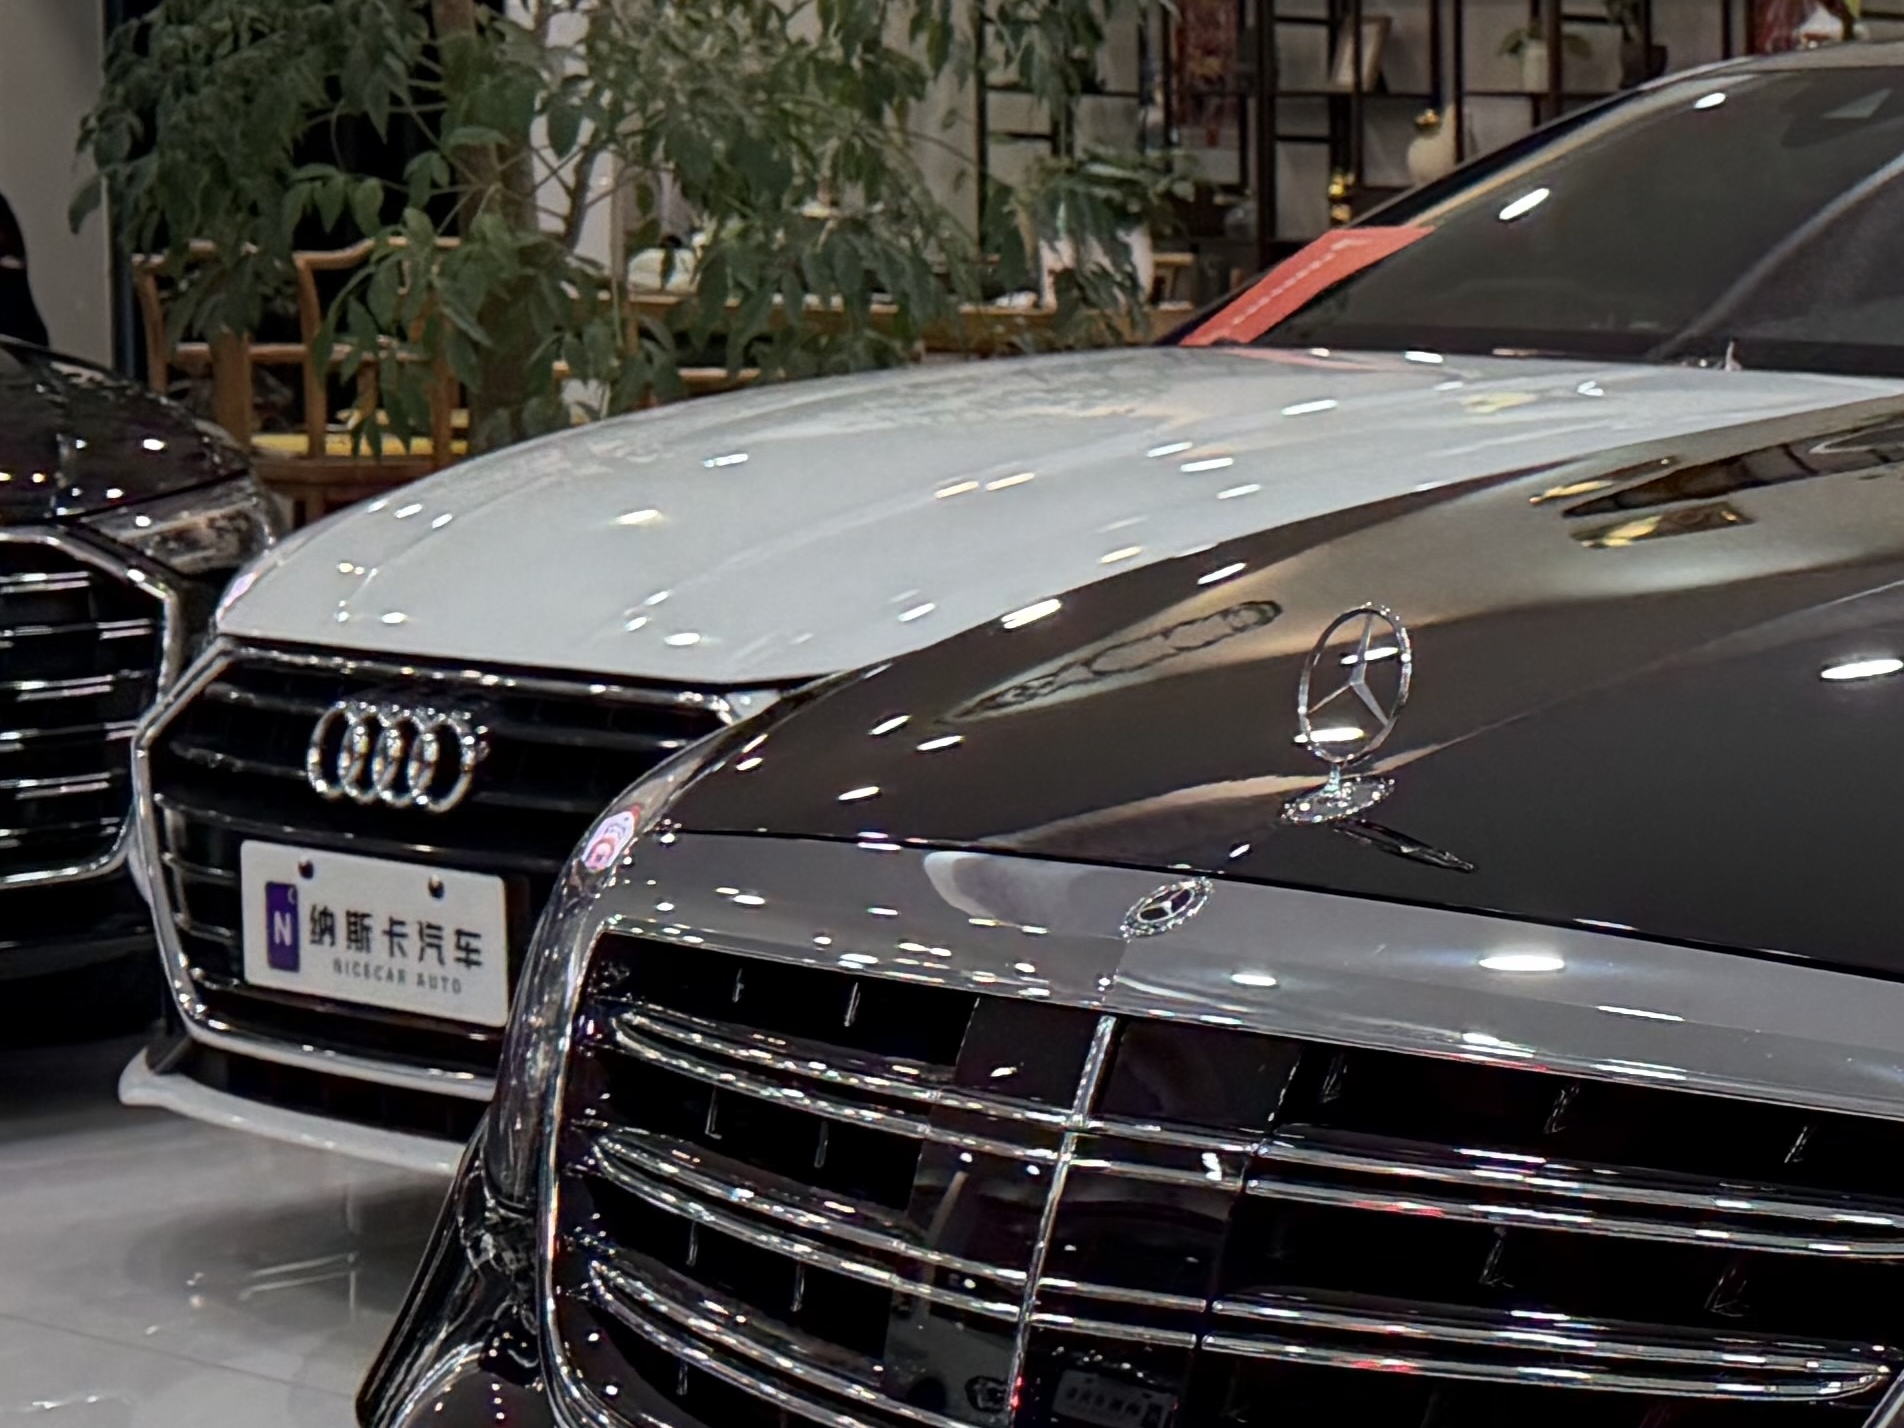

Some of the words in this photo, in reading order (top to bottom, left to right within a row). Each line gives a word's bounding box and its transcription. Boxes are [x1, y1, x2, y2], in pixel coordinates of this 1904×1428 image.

[272, 911, 292, 948] N
[309, 904, 482, 970] 纳斯卡汽车
[416, 972, 462, 995] AUTO
